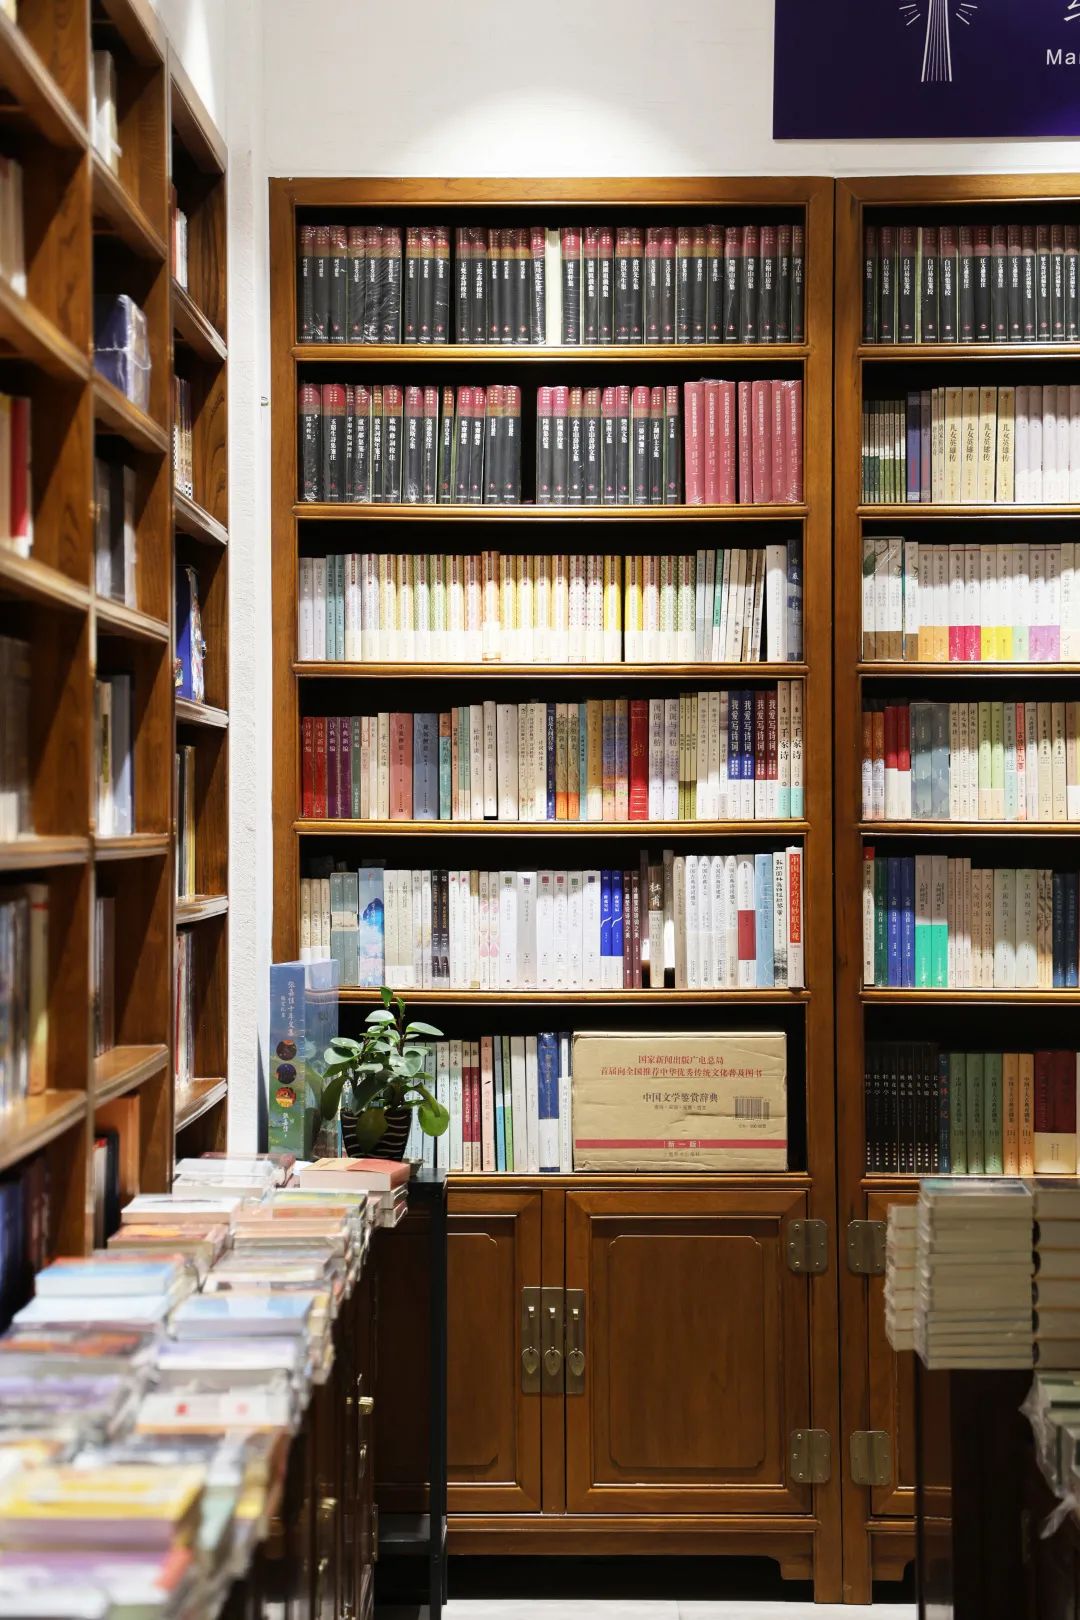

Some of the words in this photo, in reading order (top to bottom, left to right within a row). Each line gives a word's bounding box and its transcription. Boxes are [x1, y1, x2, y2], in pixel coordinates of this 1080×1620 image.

[949, 424, 958, 462] 儿女英雄传
[966, 423, 975, 462] 儿女英雄传
[983, 423, 992, 462] 儿女英雄传
[1002, 424, 1010, 462] 儿女英雄传
[780, 728, 789, 760] 千家诗
[792, 728, 801, 760] 千家诗
[649, 882, 663, 907] 杜甫
[600, 1067, 763, 1078] 首届向全国推荐中华优秀传统文化普及图书
[638, 1055, 724, 1065] 国家新闻出版广电总局
[643, 1092, 718, 1103] 中国文学鉴赏辞典
